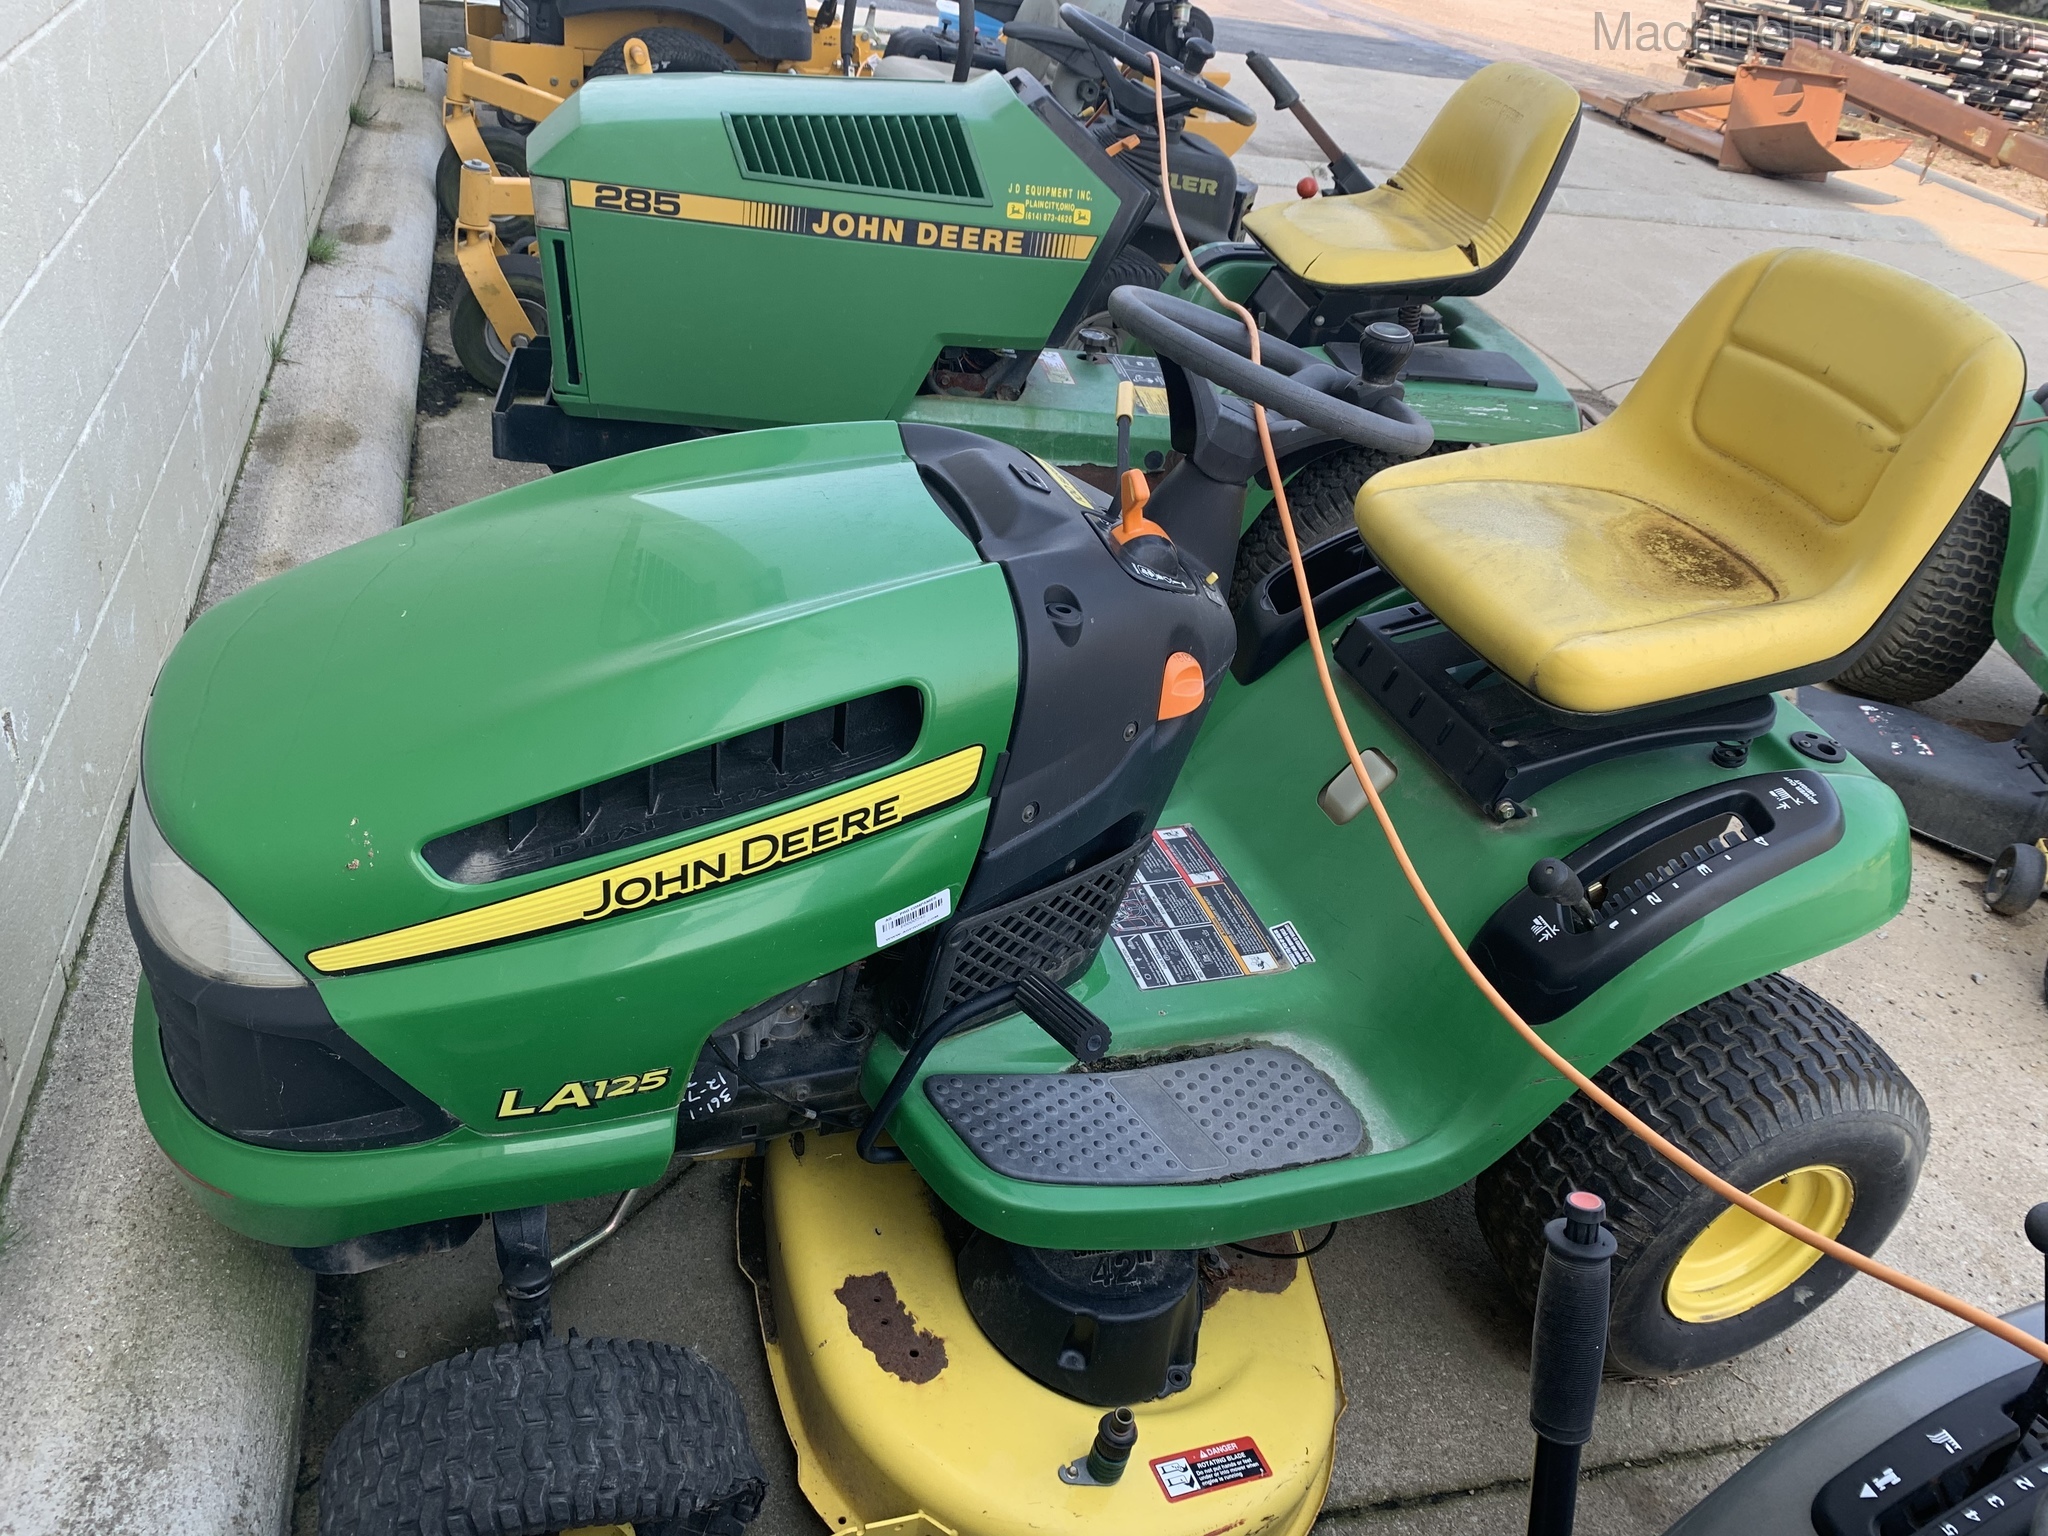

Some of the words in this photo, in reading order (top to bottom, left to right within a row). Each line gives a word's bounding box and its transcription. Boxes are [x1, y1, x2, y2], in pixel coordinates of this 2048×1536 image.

[595, 184, 681, 216] 285
[1008, 183, 1013, 194] J
[1015, 183, 1021, 194] D
[1025, 184, 1073, 199] EQUIPMENT
[1077, 190, 1093, 202] INC.
[1025, 211, 1042, 221] (614)
[812, 210, 904, 243] JOHN
[917, 225, 1024, 254] DEERE
[1783, 776, 1797, 786] CUT
[1794, 779, 1817, 797] HEIGHT
[1795, 786, 1819, 804] MOWER
[1753, 836, 1770, 847] 4
[582, 852, 728, 918] JOHN
[741, 794, 901, 873] DEERE
[1696, 863, 1713, 876] 3
[900, 908, 910, 916] PRO
[910, 896, 937, 911] COMPANIES
[1646, 891, 1663, 906] 2
[1608, 920, 1620, 930] 1
[496, 1067, 671, 1119] LA125
[688, 1087, 733, 1120] 361.1
[1206, 1442, 1238, 1457] DANGER
[1196, 1455, 1227, 1469] ROTATING
[1227, 1452, 1246, 1461] BLADE
[1213, 1465, 1222, 1473] put
[1221, 1462, 1237, 1471] hands
[1242, 1457, 1253, 1465] feet
[1199, 1473, 1214, 1482] under
[1230, 1466, 1247, 1474] mower
[1247, 1462, 1260, 1470] when
[1201, 1478, 1219, 1487] engine
[1224, 1472, 1244, 1481] running
[2013, 1475, 2035, 1491] 2
[1987, 1492, 2005, 1508] 3
[1963, 1508, 1981, 1522] 4
[1939, 1522, 1959, 1536] 5
